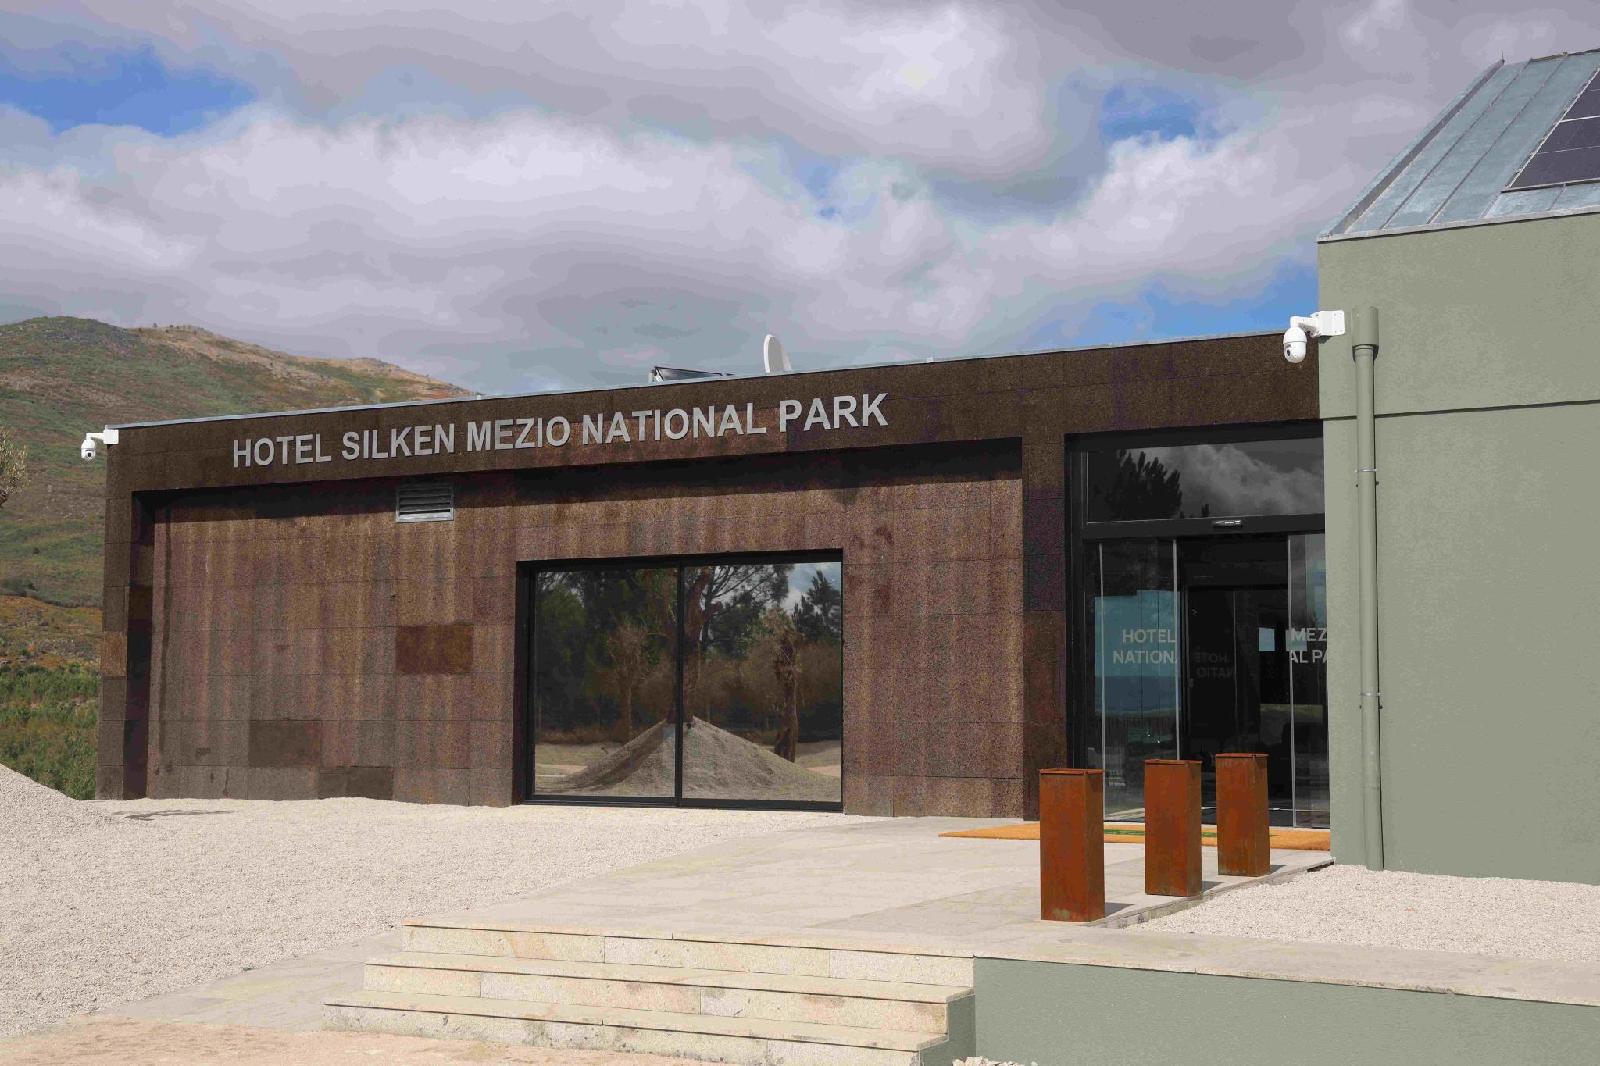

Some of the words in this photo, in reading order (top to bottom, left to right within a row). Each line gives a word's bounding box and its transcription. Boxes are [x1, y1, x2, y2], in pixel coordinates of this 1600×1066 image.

[233, 433, 332, 468] HOTEL
[341, 423, 455, 460] SILKEN
[467, 416, 571, 452] MEZIO
[582, 402, 767, 445] NATIONAL
[779, 392, 889, 433] PARK
[1122, 628, 1176, 643] HOTEL
[1112, 650, 1177, 665] NATION
